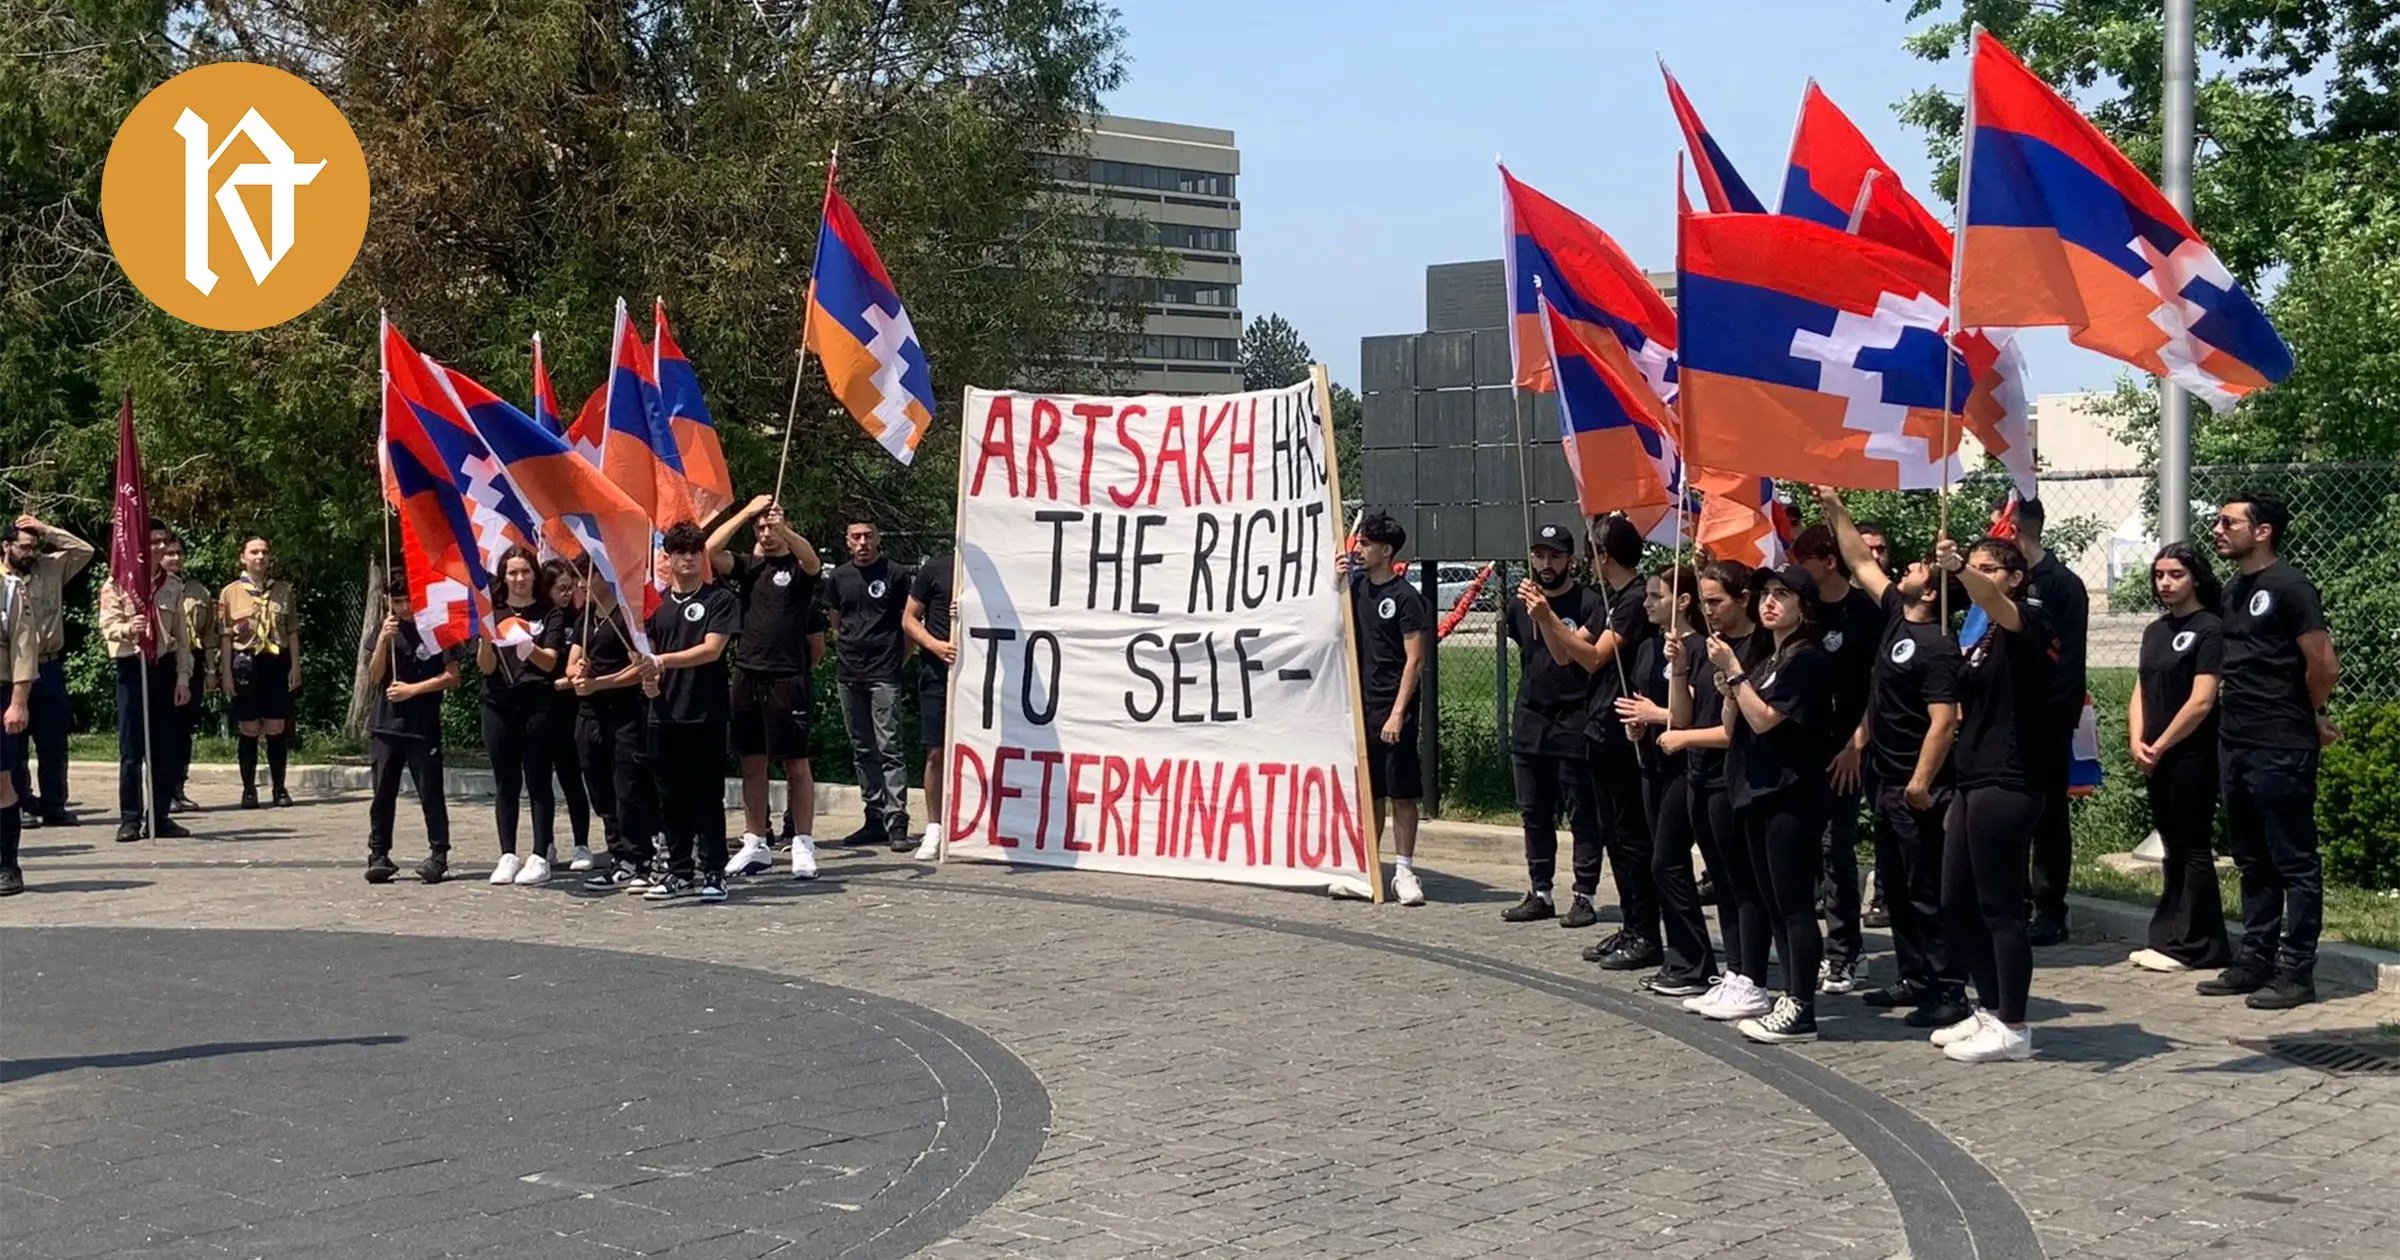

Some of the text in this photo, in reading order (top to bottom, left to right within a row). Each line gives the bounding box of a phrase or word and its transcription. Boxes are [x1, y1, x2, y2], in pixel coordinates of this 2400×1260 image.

[970, 396, 1256, 509] ARTSAKH
[1035, 501, 1324, 614] THE RIGHT
[969, 627, 1313, 730] TO SELF-
[948, 743, 1367, 873] DETERMINATION
